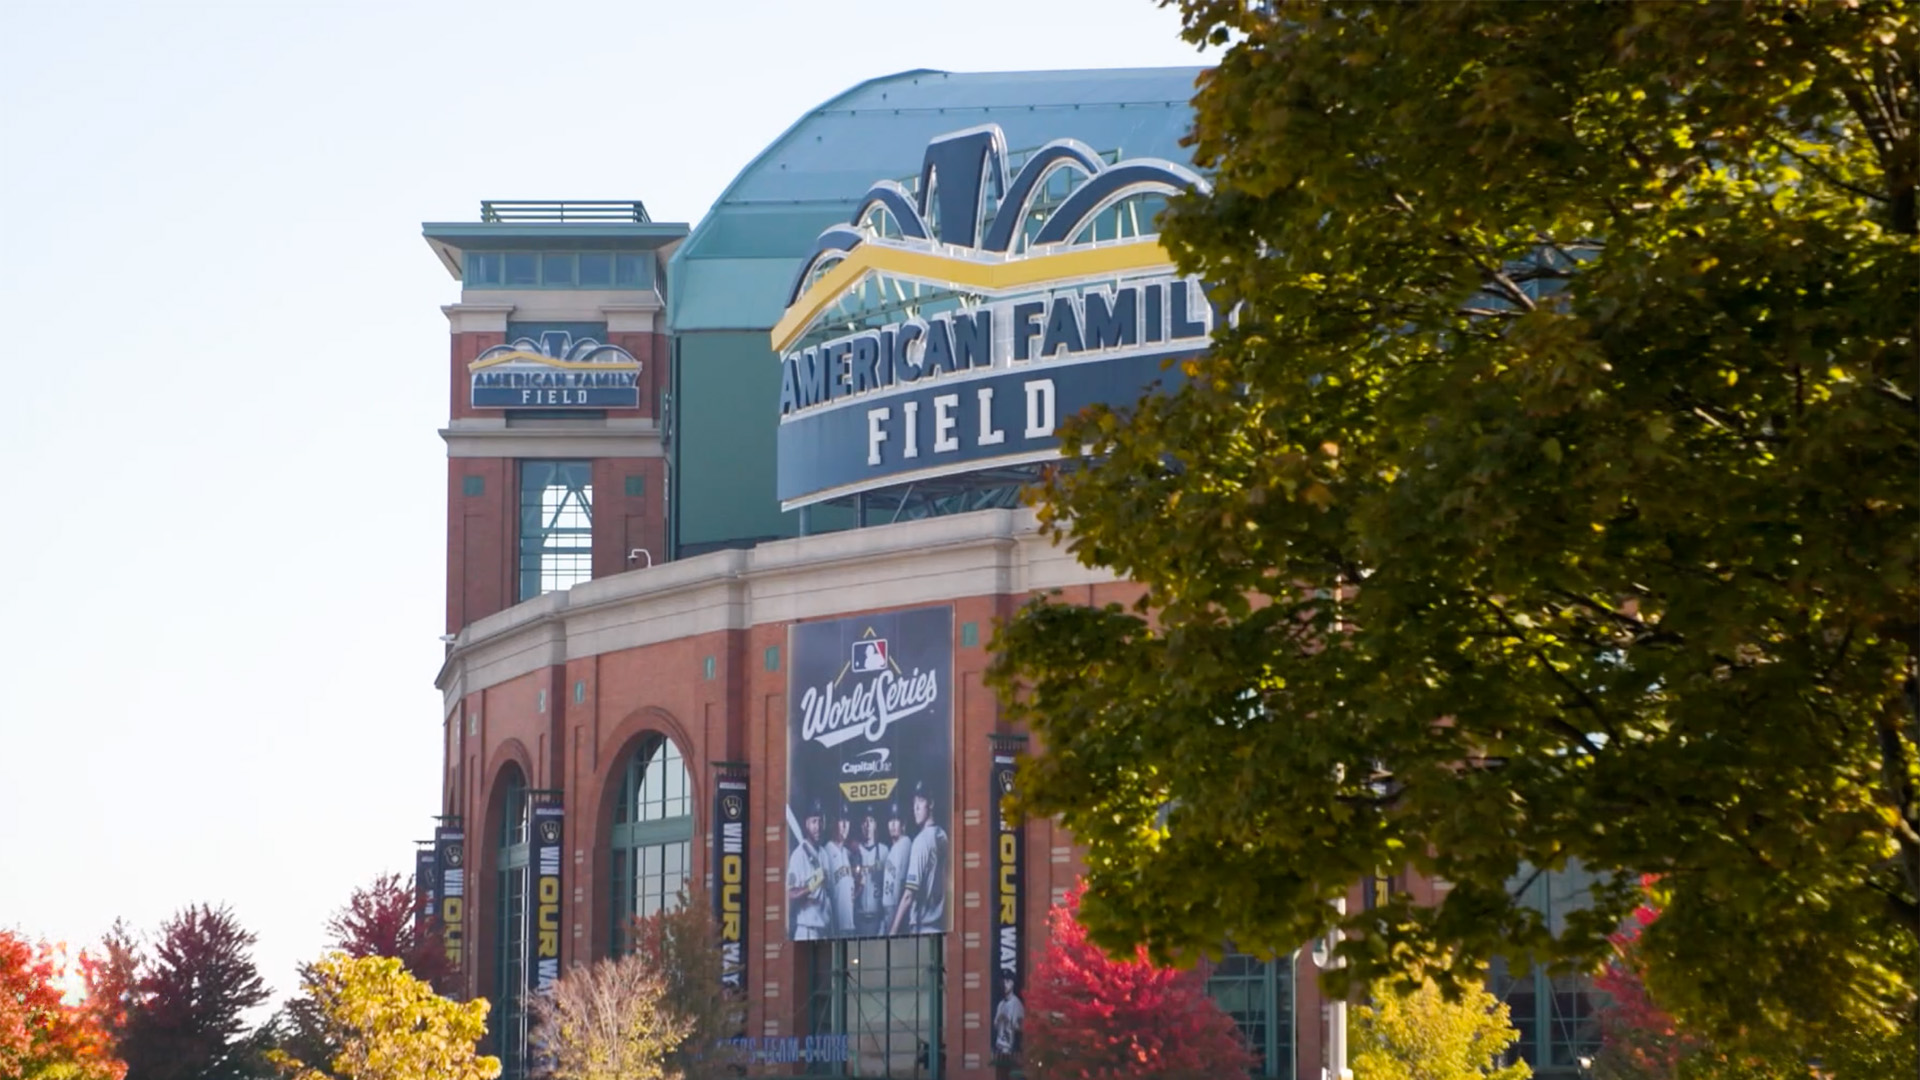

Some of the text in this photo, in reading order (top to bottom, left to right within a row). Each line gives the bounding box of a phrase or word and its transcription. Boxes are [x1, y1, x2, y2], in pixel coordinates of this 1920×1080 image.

[474, 372, 637, 388] AMERICAN FAMILY
[779, 309, 992, 415] AMERICAN
[522, 390, 588, 404] FIELD
[868, 378, 1055, 466] FIELD
[800, 667, 938, 742] World Series
[850, 783, 888, 798] 2026
[723, 822, 742, 853] WIN
[540, 846, 559, 876] WIN
[1000, 833, 1016, 924] OUR
[444, 868, 464, 896] WIN
[722, 855, 742, 941] OUR
[538, 876, 559, 958] OUR
[1000, 926, 1017, 974] WAY
[764, 1036, 800, 1064] TEAM
[805, 1034, 849, 1063] STORE
